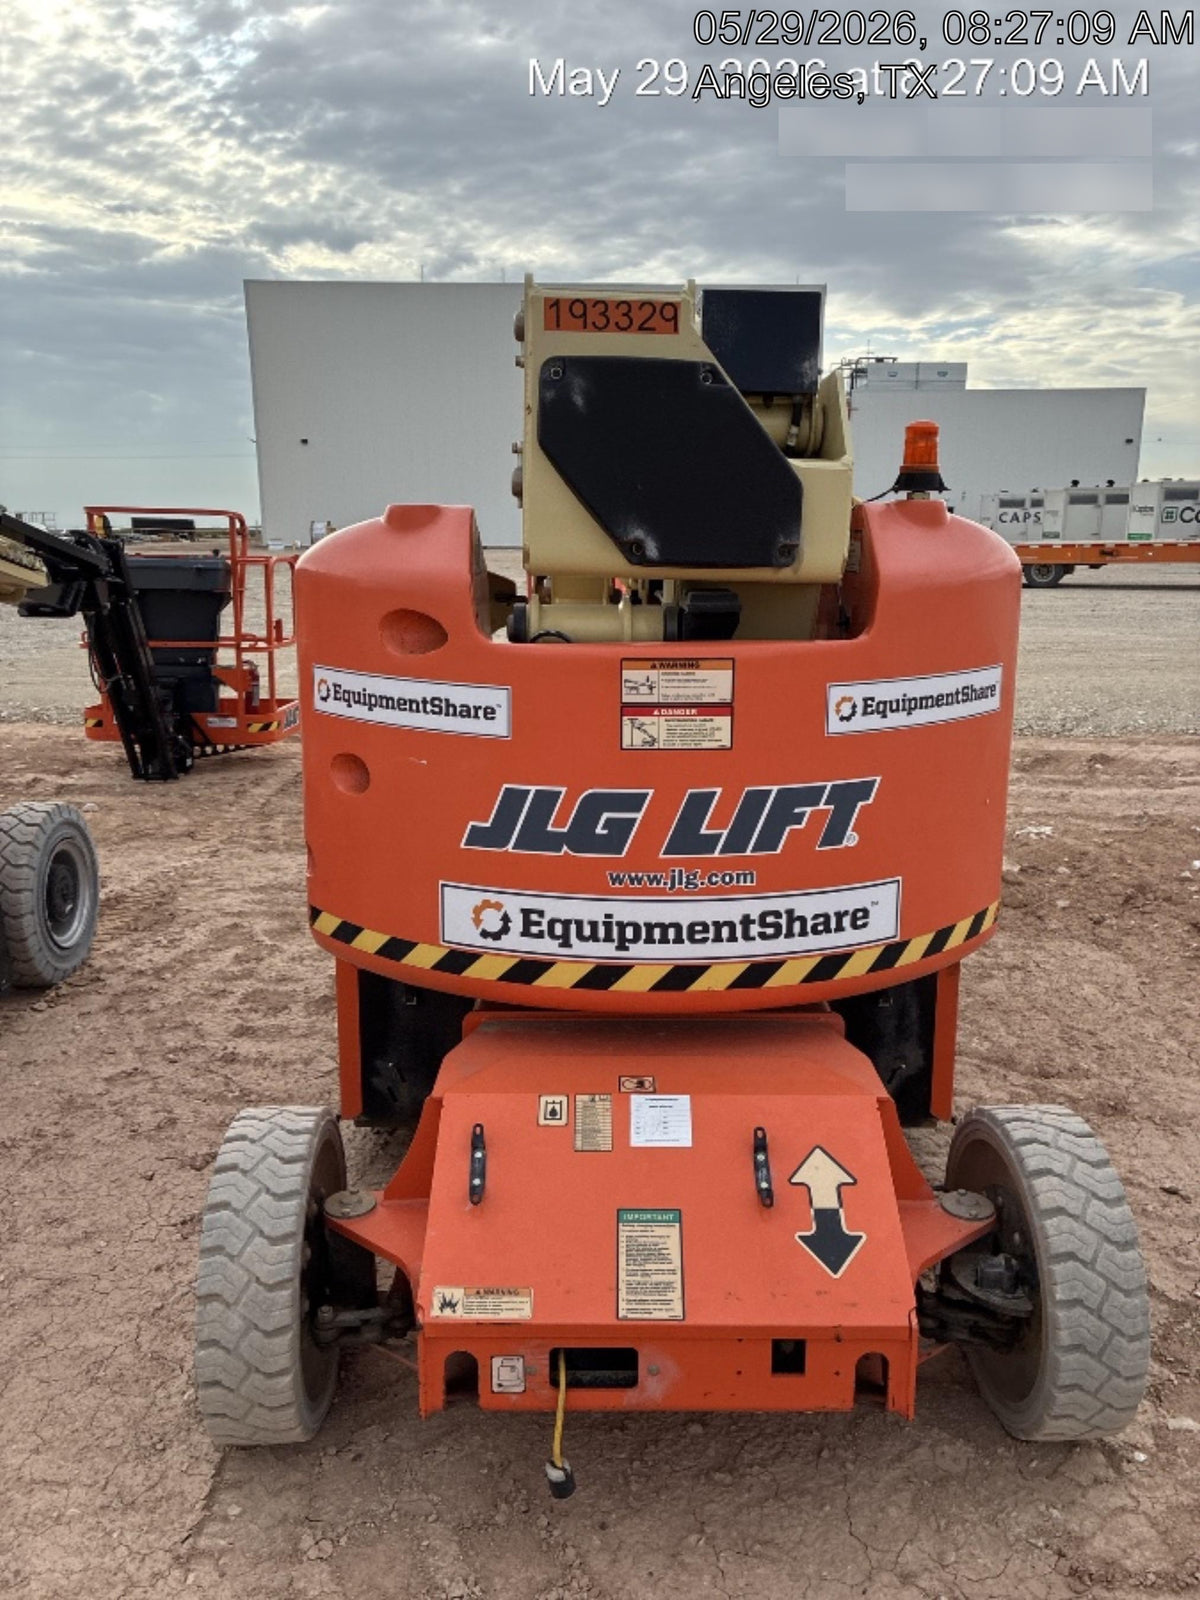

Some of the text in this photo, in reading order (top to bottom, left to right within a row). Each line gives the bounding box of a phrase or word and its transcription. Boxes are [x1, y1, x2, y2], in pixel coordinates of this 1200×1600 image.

[548, 298, 680, 334] 193329
[999, 511, 1042, 524] CAPS
[332, 683, 497, 721] EquipmentShare
[661, 708, 698, 716] DANGER
[861, 683, 997, 718] EquipmentShare
[460, 776, 882, 858] JLG LIFT
[608, 868, 756, 890] www.jlg.com
[520, 905, 871, 951] EquipmentShare
[623, 1213, 675, 1221] IMPORTANT
